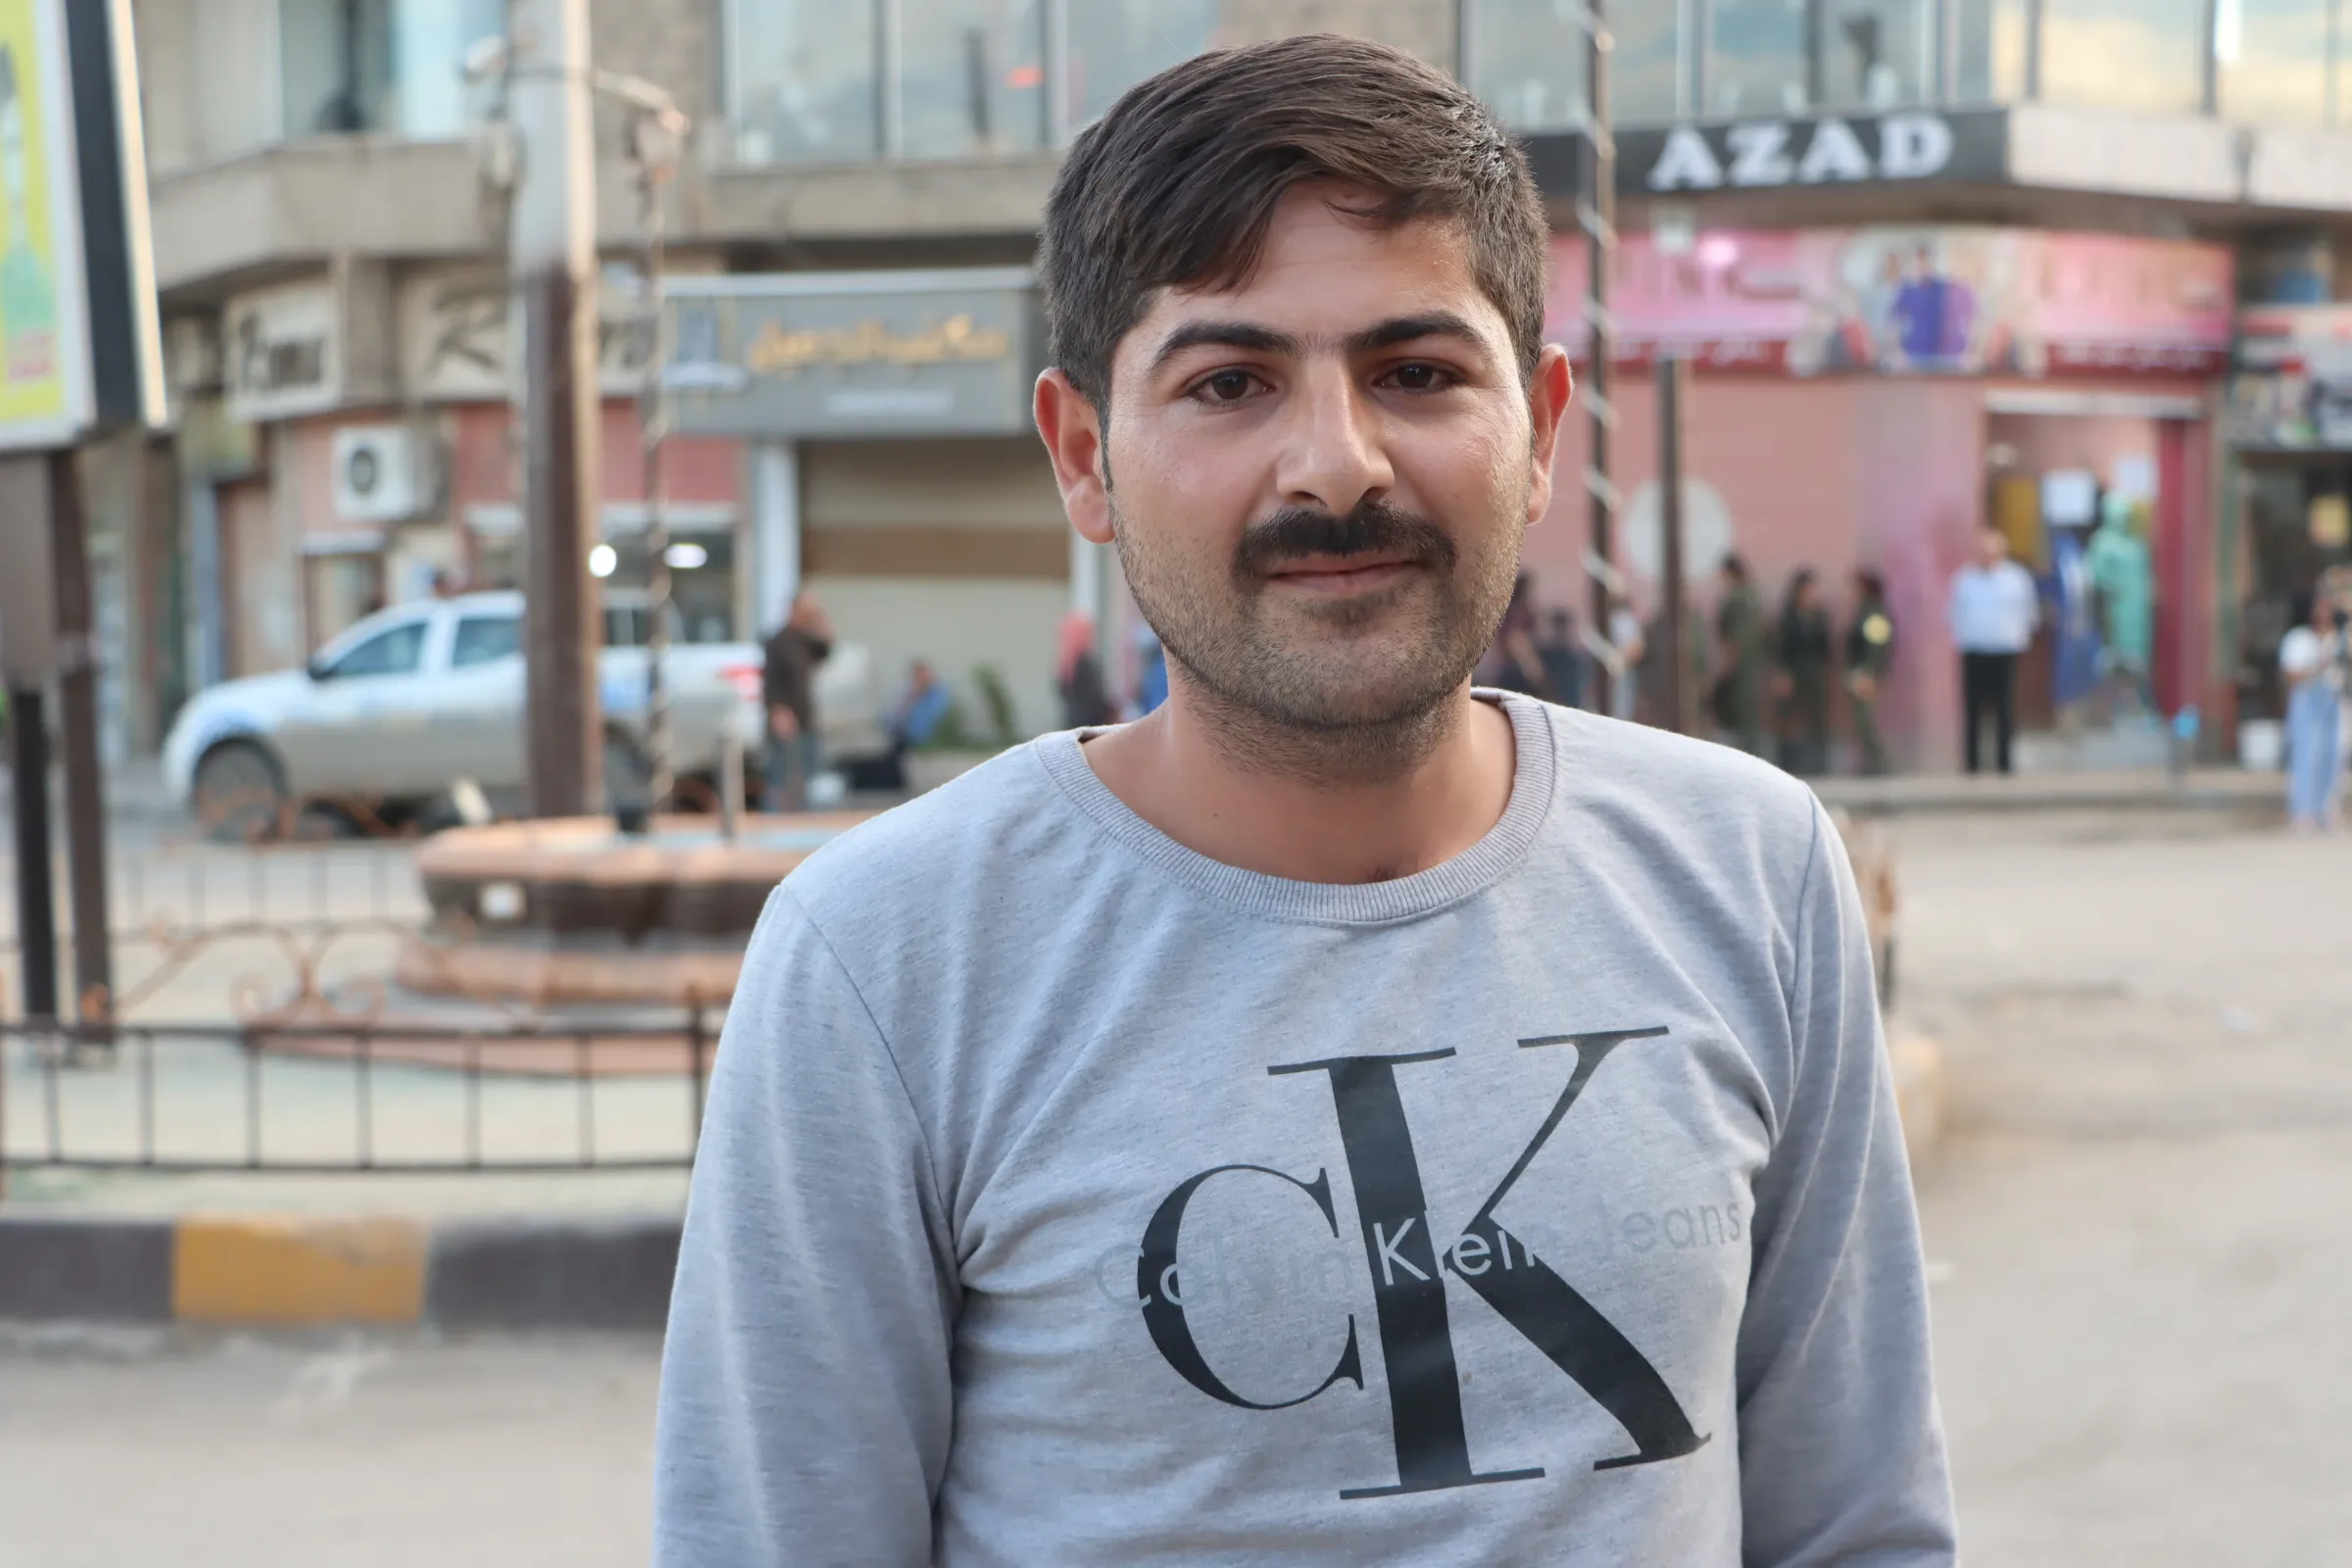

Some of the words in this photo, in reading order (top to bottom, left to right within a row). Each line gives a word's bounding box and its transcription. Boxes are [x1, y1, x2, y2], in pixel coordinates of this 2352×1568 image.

[1647, 115, 1954, 190] AZAD
[1137, 1025, 1712, 1500] CK
[1590, 1192, 1741, 1263] Jeans
